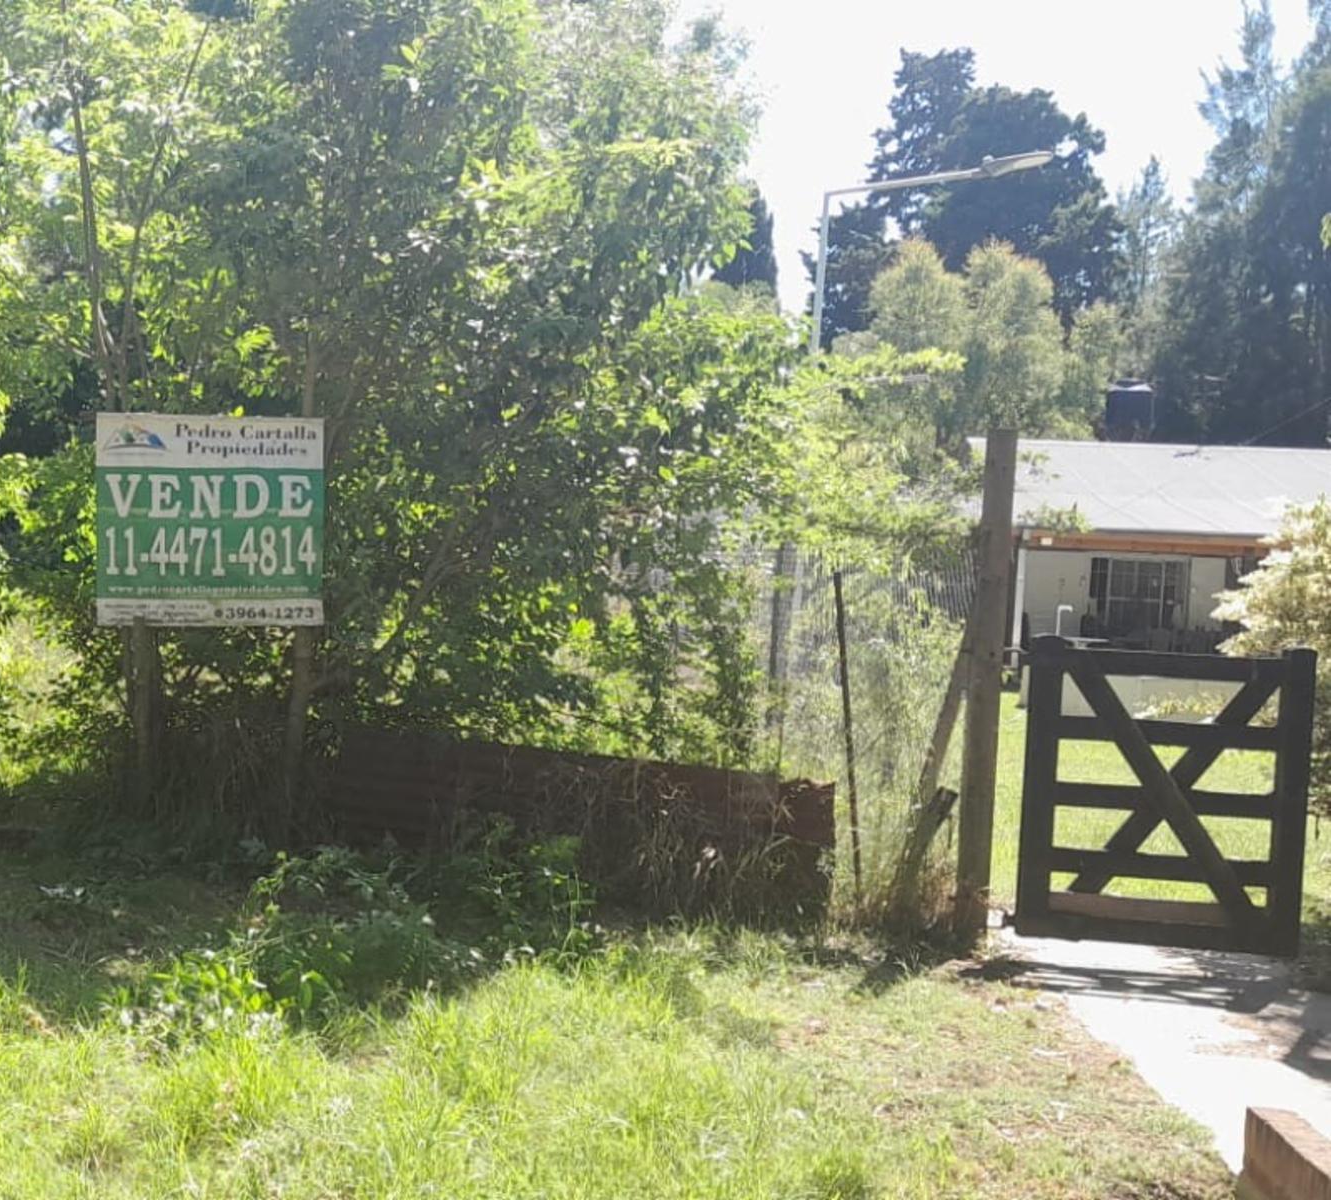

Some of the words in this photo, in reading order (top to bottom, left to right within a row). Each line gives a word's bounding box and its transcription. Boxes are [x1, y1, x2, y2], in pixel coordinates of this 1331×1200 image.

[175, 423, 232, 439] Pedro
[240, 425, 317, 440] Cartalla
[187, 441, 307, 458] Propiedades
[105, 474, 313, 519] VENDE
[105, 525, 317, 576] 11-4471-4814
